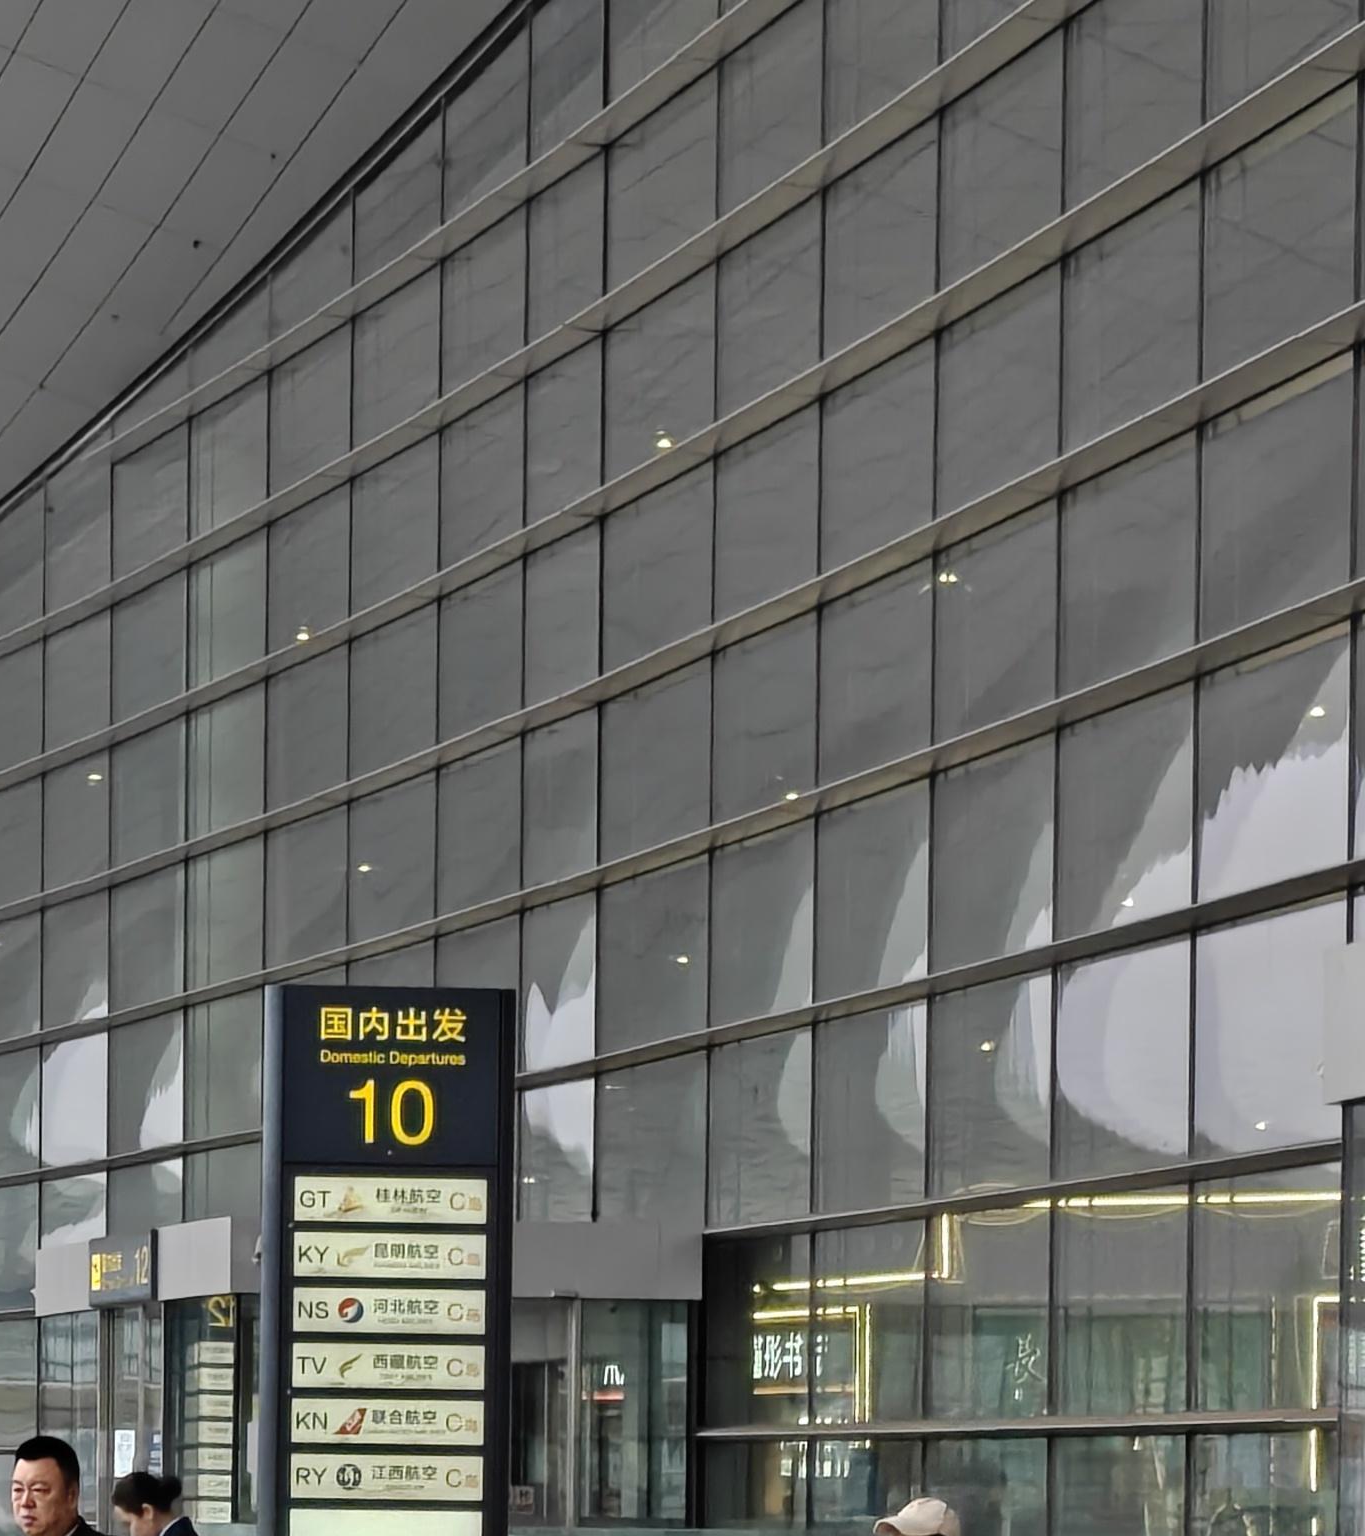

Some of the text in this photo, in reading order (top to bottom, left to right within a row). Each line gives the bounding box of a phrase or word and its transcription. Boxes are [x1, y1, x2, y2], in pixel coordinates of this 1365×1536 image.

[320, 1006, 467, 1043] 国内出发
[320, 1049, 466, 1068] Domestic Departures
[348, 1078, 435, 1146] 10
[299, 1189, 331, 1208] GT
[375, 1187, 442, 1204] 桂林航空
[298, 1245, 330, 1263] KY
[374, 1242, 439, 1259] 昆明航空
[134, 1245, 150, 1285] 12
[297, 1301, 329, 1319] NS
[373, 1298, 440, 1315] 河北航空
[297, 1356, 327, 1375] TV
[372, 1354, 439, 1370] 西藏航空
[296, 1411, 327, 1430] KN
[371, 1409, 437, 1425] 联合航空
[296, 1467, 327, 1485] RY
[371, 1465, 438, 1482] 江西航空
